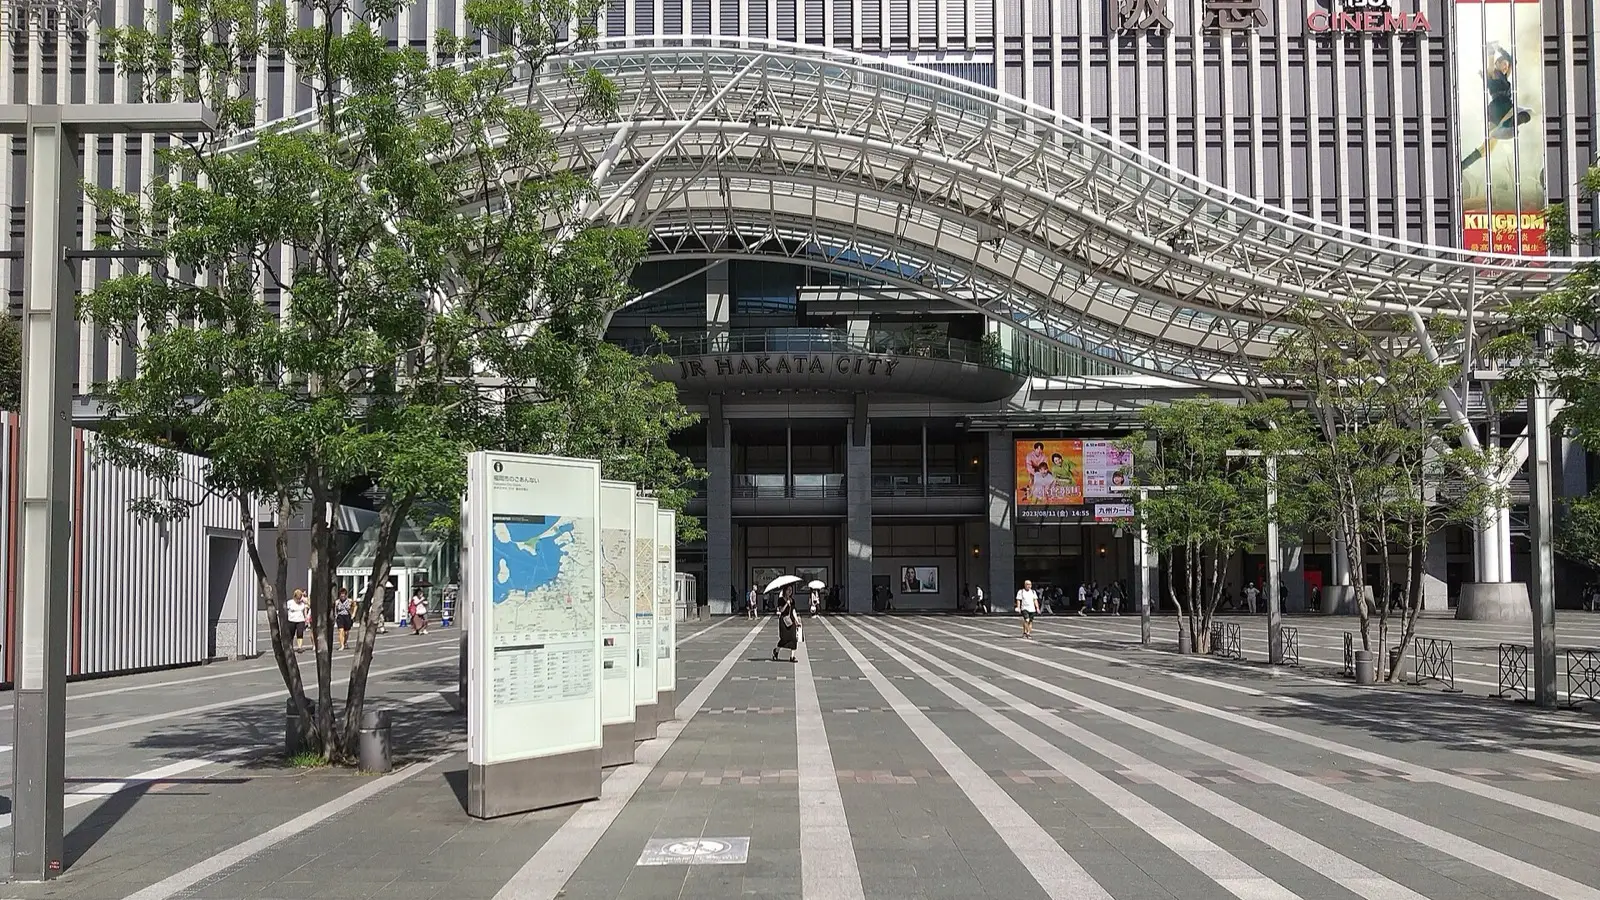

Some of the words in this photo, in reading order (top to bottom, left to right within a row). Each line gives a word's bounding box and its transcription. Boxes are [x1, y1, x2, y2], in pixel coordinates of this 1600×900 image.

[1307, 11, 1431, 32] CINEMA
[1464, 214, 1545, 231] KINGDOM
[680, 361, 706, 379] JR
[715, 356, 824, 375] HAKATA
[837, 357, 900, 376] CITY
